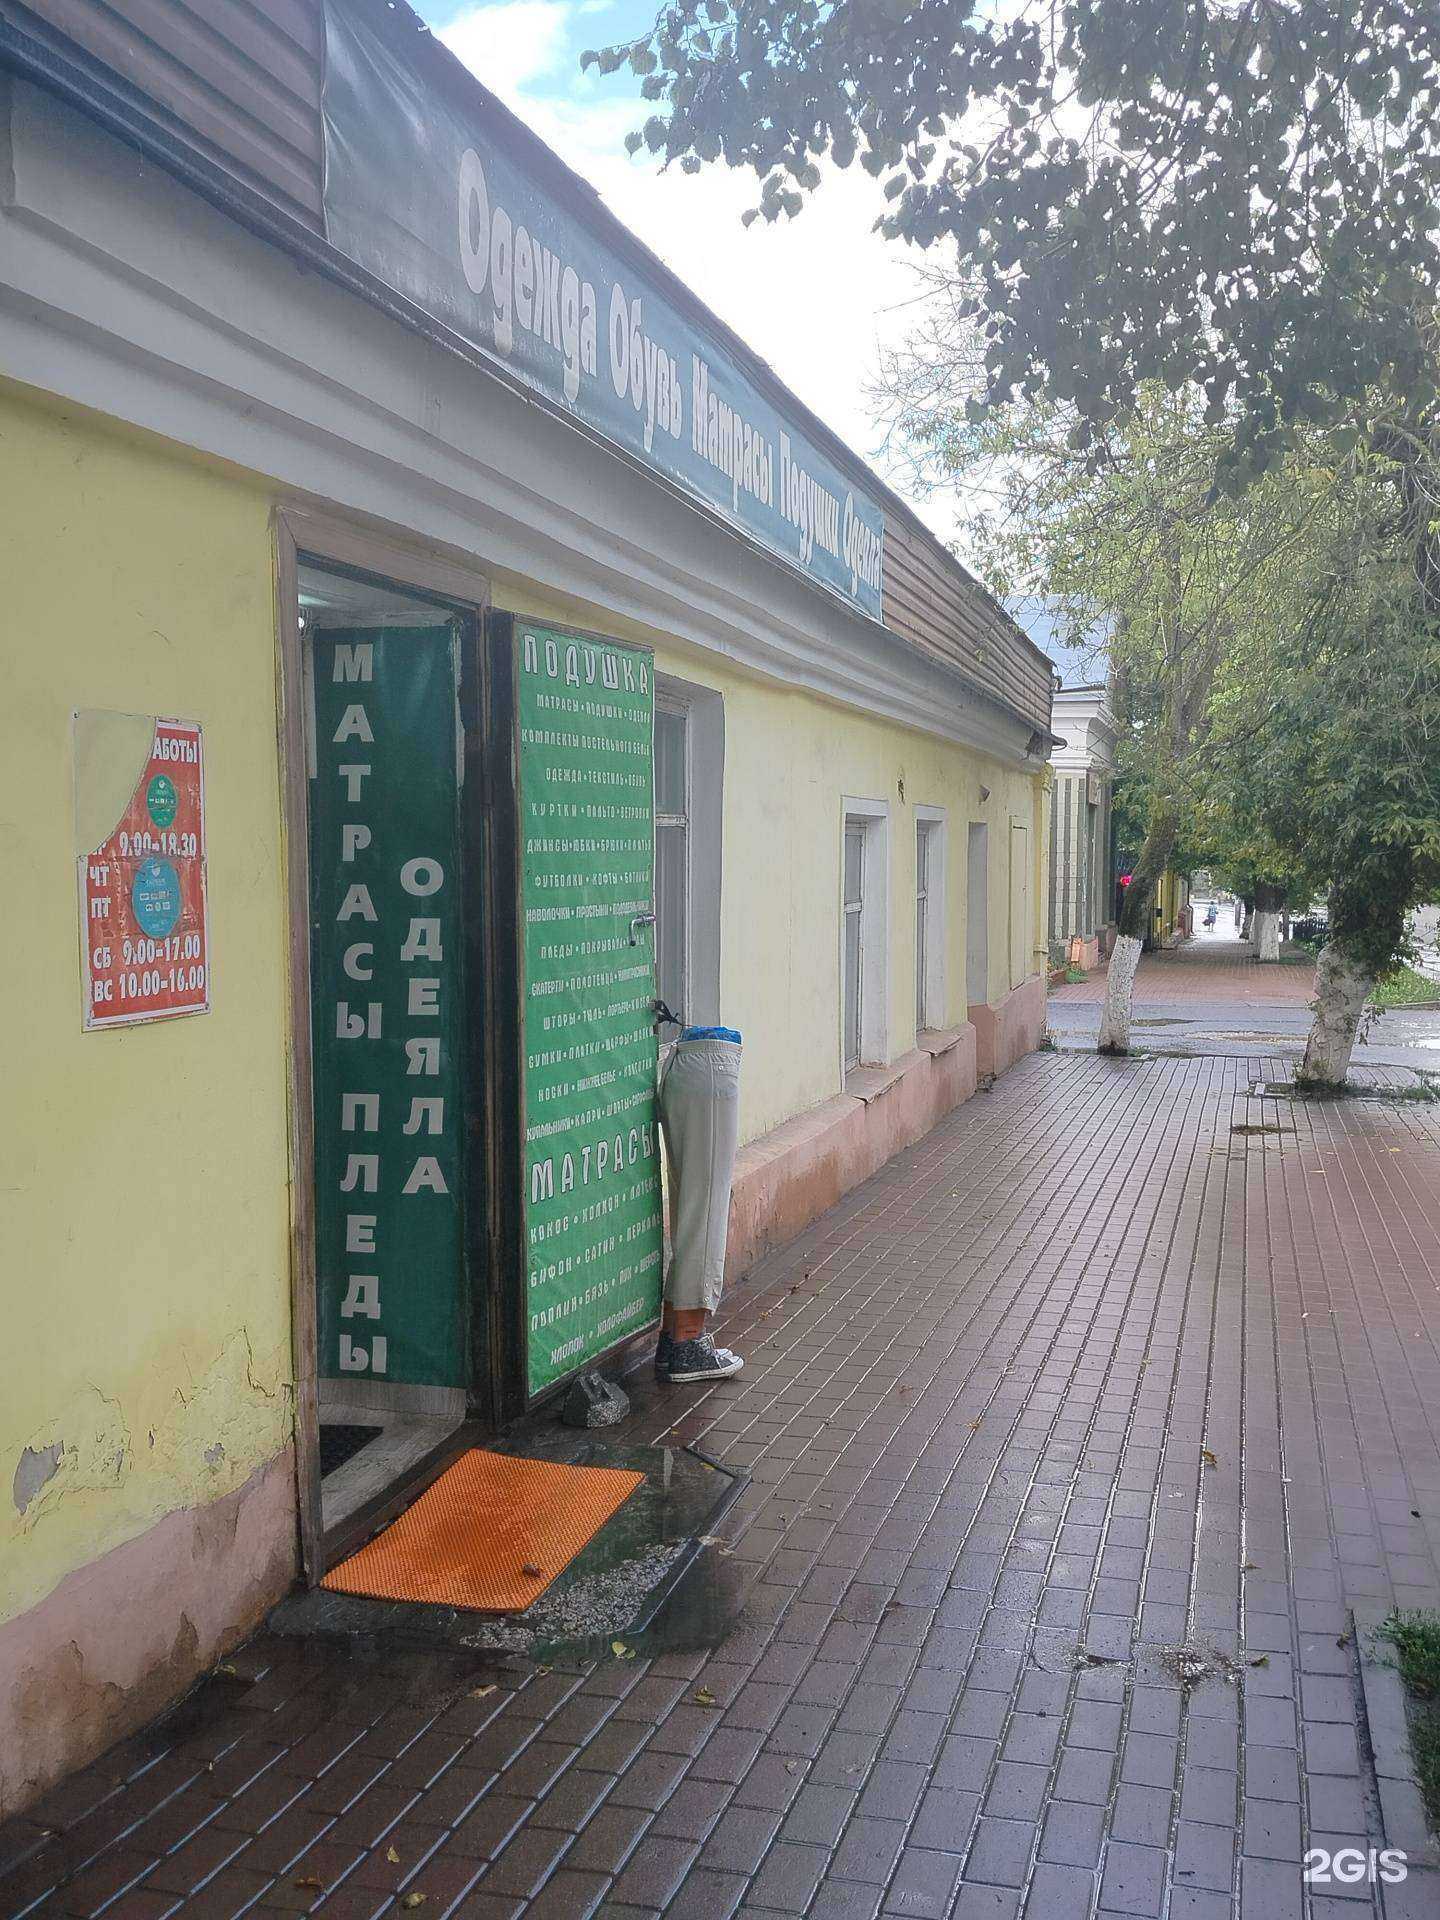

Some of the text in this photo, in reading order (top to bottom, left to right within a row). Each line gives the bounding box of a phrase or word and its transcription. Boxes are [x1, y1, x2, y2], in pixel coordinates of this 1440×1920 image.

[458, 148, 597, 402] Одежда
[609, 282, 682, 453] Обувь
[692, 354, 773, 511] Матрасы
[779, 430, 840, 565] Подушки
[523, 634, 649, 694] ПОДУШКА
[536, 694, 579, 712] МАТРАСЫ
[586, 702, 622, 719] ПОДУШКИ
[521, 729, 579, 747] КОМПЛЕКТЫ
[546, 768, 582, 783] ОДЕЖДА
[588, 770, 623, 785] ТЕКСТИЛЬ
[531, 803, 577, 817] КУРТКИ
[586, 805, 615, 818] ПАЛЬТО
[527, 839, 569, 854] ДЖИНСЫ
[573, 839, 596, 852] ЮБКИ
[90, 866, 109, 886] ЧТ
[535, 874, 583, 887] ФУТБОЛКИ
[592, 873, 618, 885] КОФТЫ
[91, 897, 111, 918] ПТ
[526, 906, 570, 922] НАВОЛОЧКИ
[93, 947, 112, 969] СБ
[541, 944, 573, 959] ПЛЕДЫ
[94, 965, 204, 1002] ВС 10.00-16.00
[570, 972, 614, 990] ПОЛОТЕНЦА
[333, 643, 387, 1373] МАТРАСЫ ПЛЕДЫ
[543, 1012, 576, 1030] ШТОРЫ
[583, 1007, 602, 1022] ТЮЛЬ
[400, 857, 449, 1193] ОДЕЯЛА
[528, 1050, 561, 1069] СУМКИ
[569, 1040, 600, 1059] ПЛАТКИ
[538, 1083, 569, 1102] НОСКИ
[575, 1107, 601, 1127] КАПРИ
[531, 1122, 654, 1204] МАТРАСЫ
[530, 1216, 569, 1244] КОКОС
[585, 1236, 615, 1263] САТИН
[531, 1296, 577, 1331] ПОПЛИН
[585, 1280, 609, 1305] БЯЗЬ
